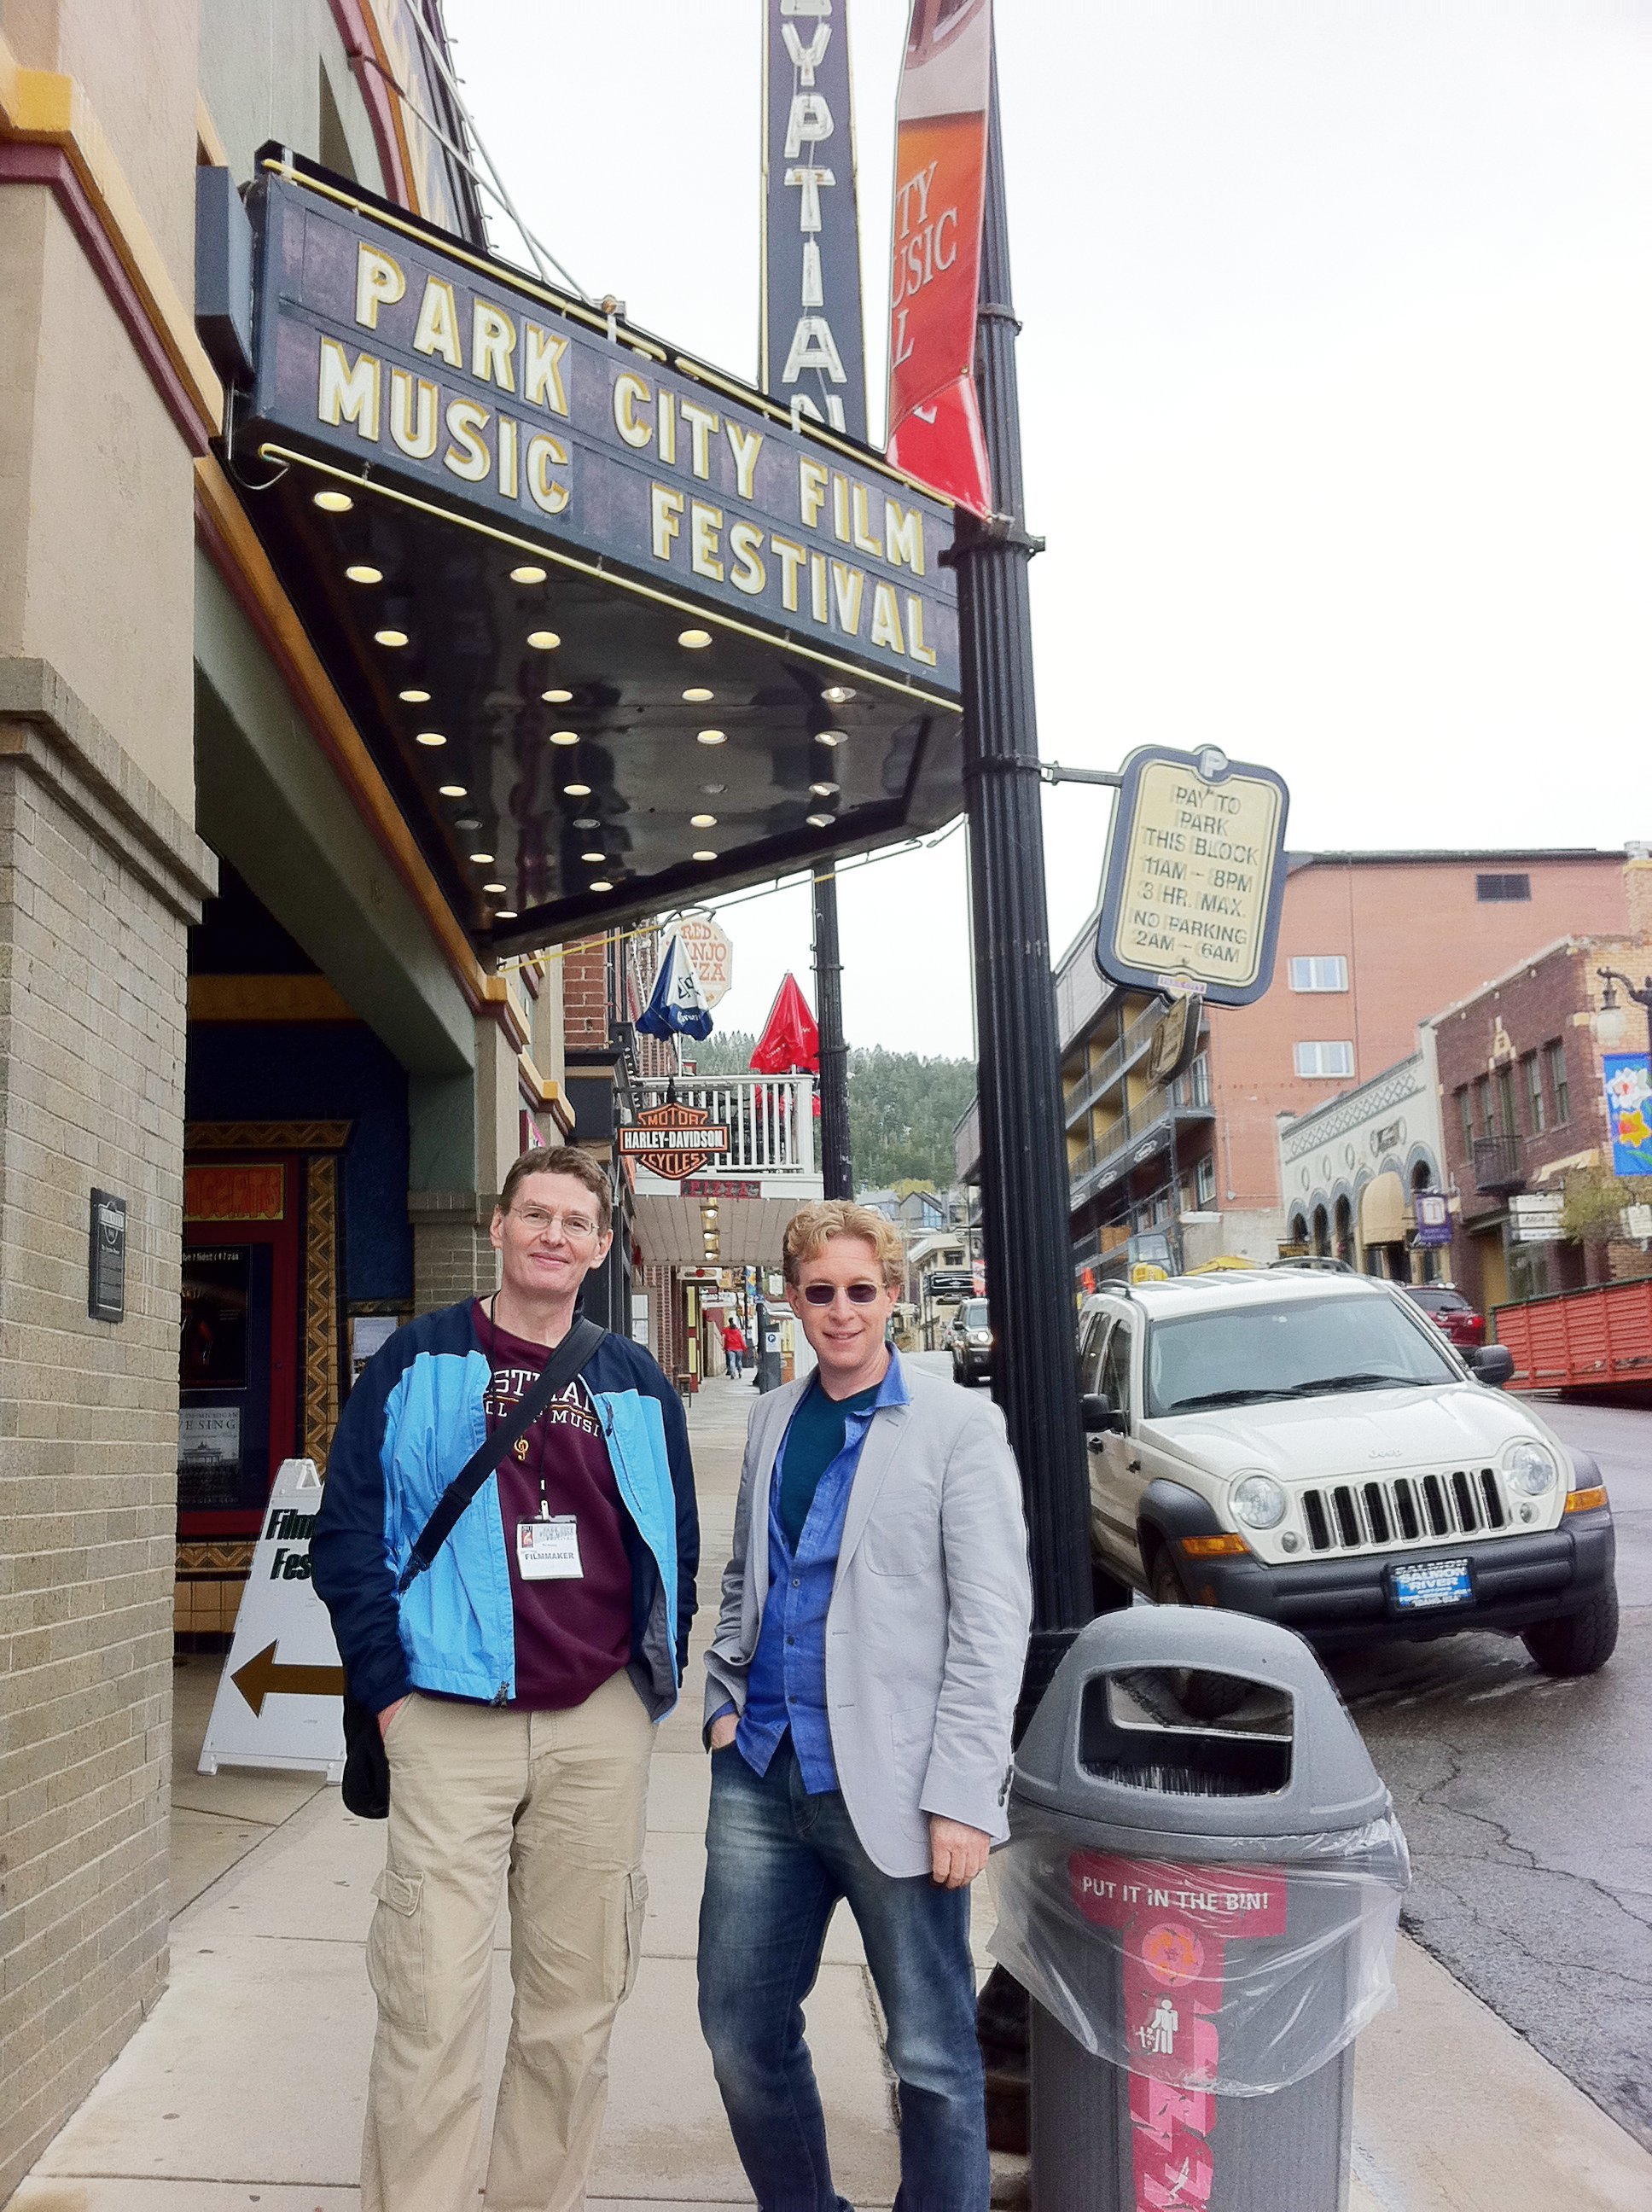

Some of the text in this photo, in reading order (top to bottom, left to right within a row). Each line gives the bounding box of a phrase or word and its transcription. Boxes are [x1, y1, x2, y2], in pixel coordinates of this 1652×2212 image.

[780, 0, 848, 434] YPTIAN
[355, 240, 926, 578] PARK CITY FILM
[317, 335, 937, 667] MUSIC FESTIVAL
[1175, 786, 1242, 816] PAY TO
[1180, 811, 1229, 837] PARK
[1144, 828, 1259, 866] THIS BLOCK
[1144, 857, 1187, 881] 11AM
[1213, 869, 1254, 894] 8PM
[1142, 882, 1247, 919] 3 HR. MAX.
[681, 923, 712, 940] RED
[1133, 909, 1248, 945] NO PARKING
[681, 942, 727, 962] NJO
[1136, 930, 1175, 952] 2AM
[1201, 943, 1241, 964] 6AM
[693, 963, 726, 981] ZA
[648, 1108, 699, 1126] MOTOR
[624, 1130, 724, 1150] HARLEY-DAVIDSON
[649, 1152, 701, 1174] CYCLES
[197, 1419, 236, 1430] SING
[525, 1552, 574, 1561] FILMMAKER
[1408, 1576, 1458, 1592] RIVER
[1082, 1876, 1269, 1911] PUT IT IN THE BIN!
